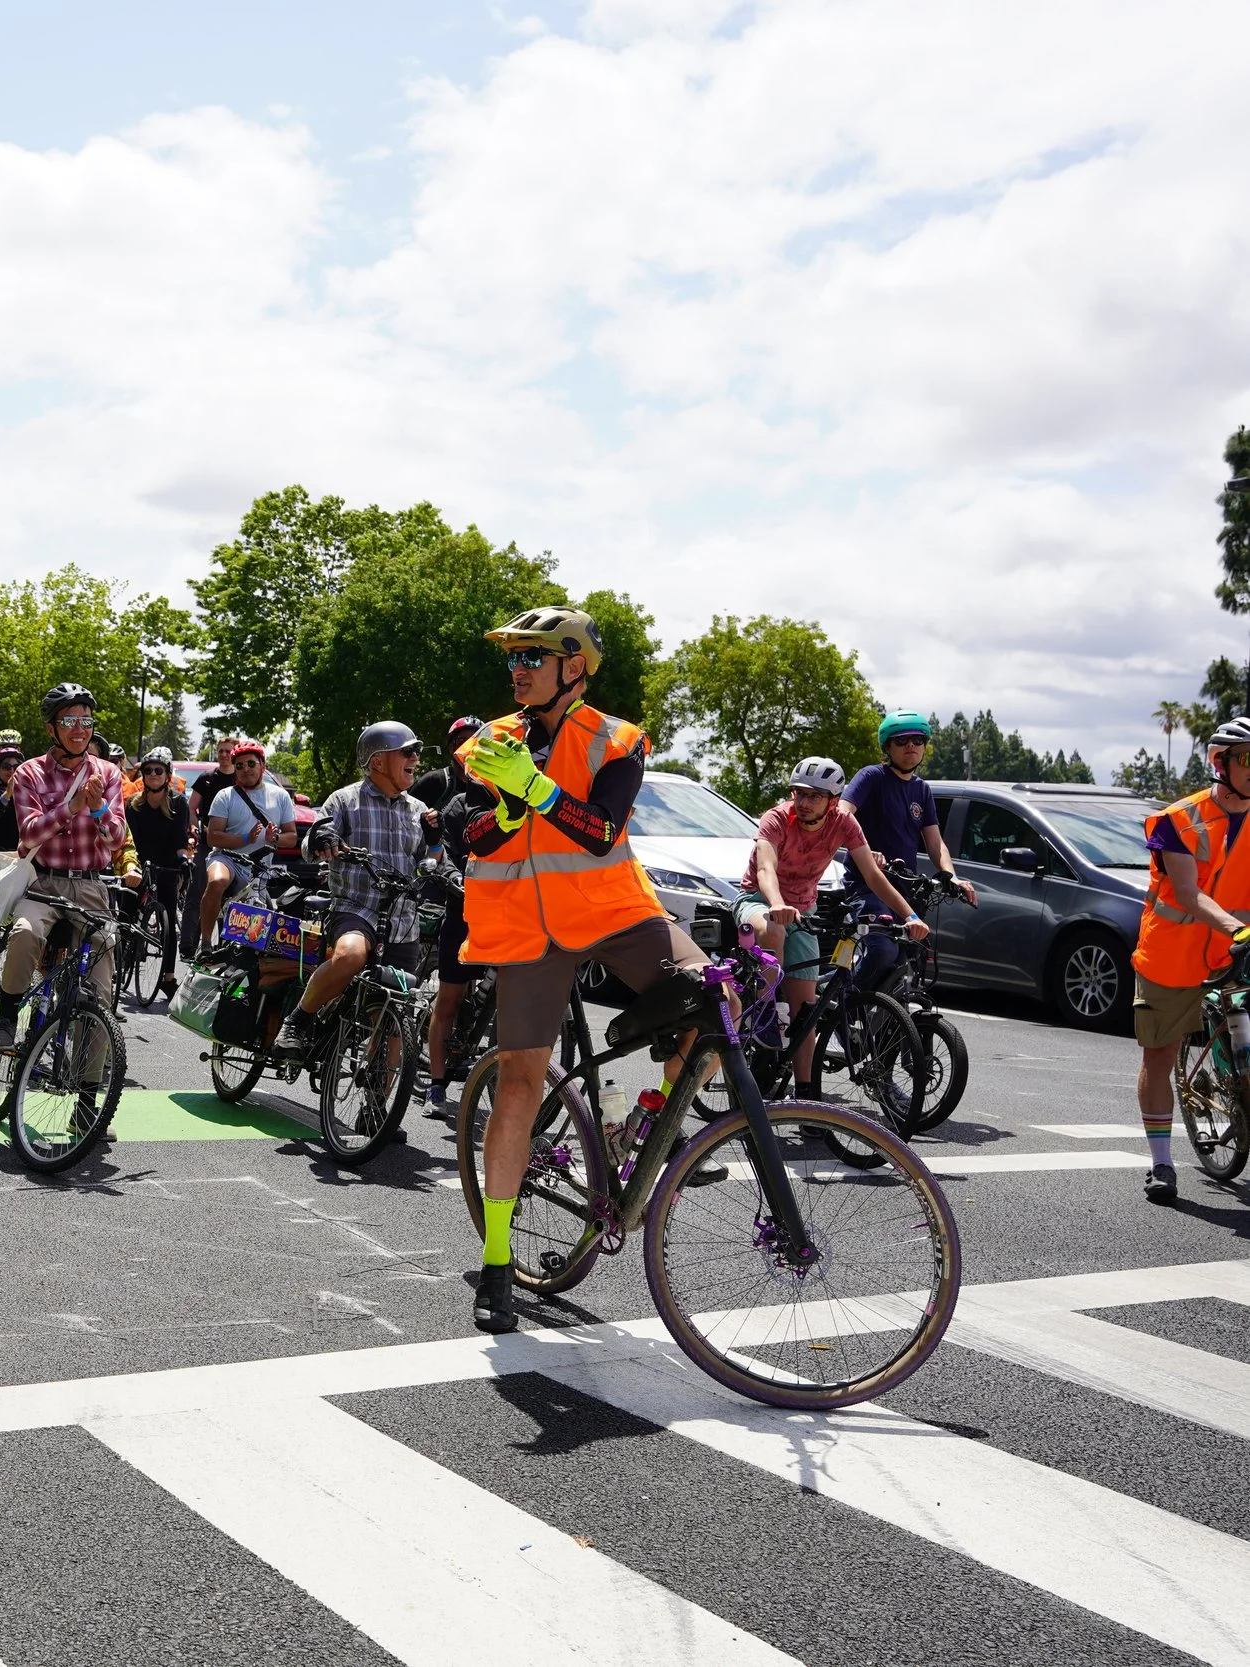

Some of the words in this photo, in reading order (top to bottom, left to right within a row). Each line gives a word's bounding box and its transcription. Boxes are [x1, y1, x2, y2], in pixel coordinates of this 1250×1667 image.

[558, 810, 586, 831] CUSTOM
[585, 825, 606, 840] SHEDS
[228, 908, 250, 929] Cuties
[276, 928, 301, 946] Cut
